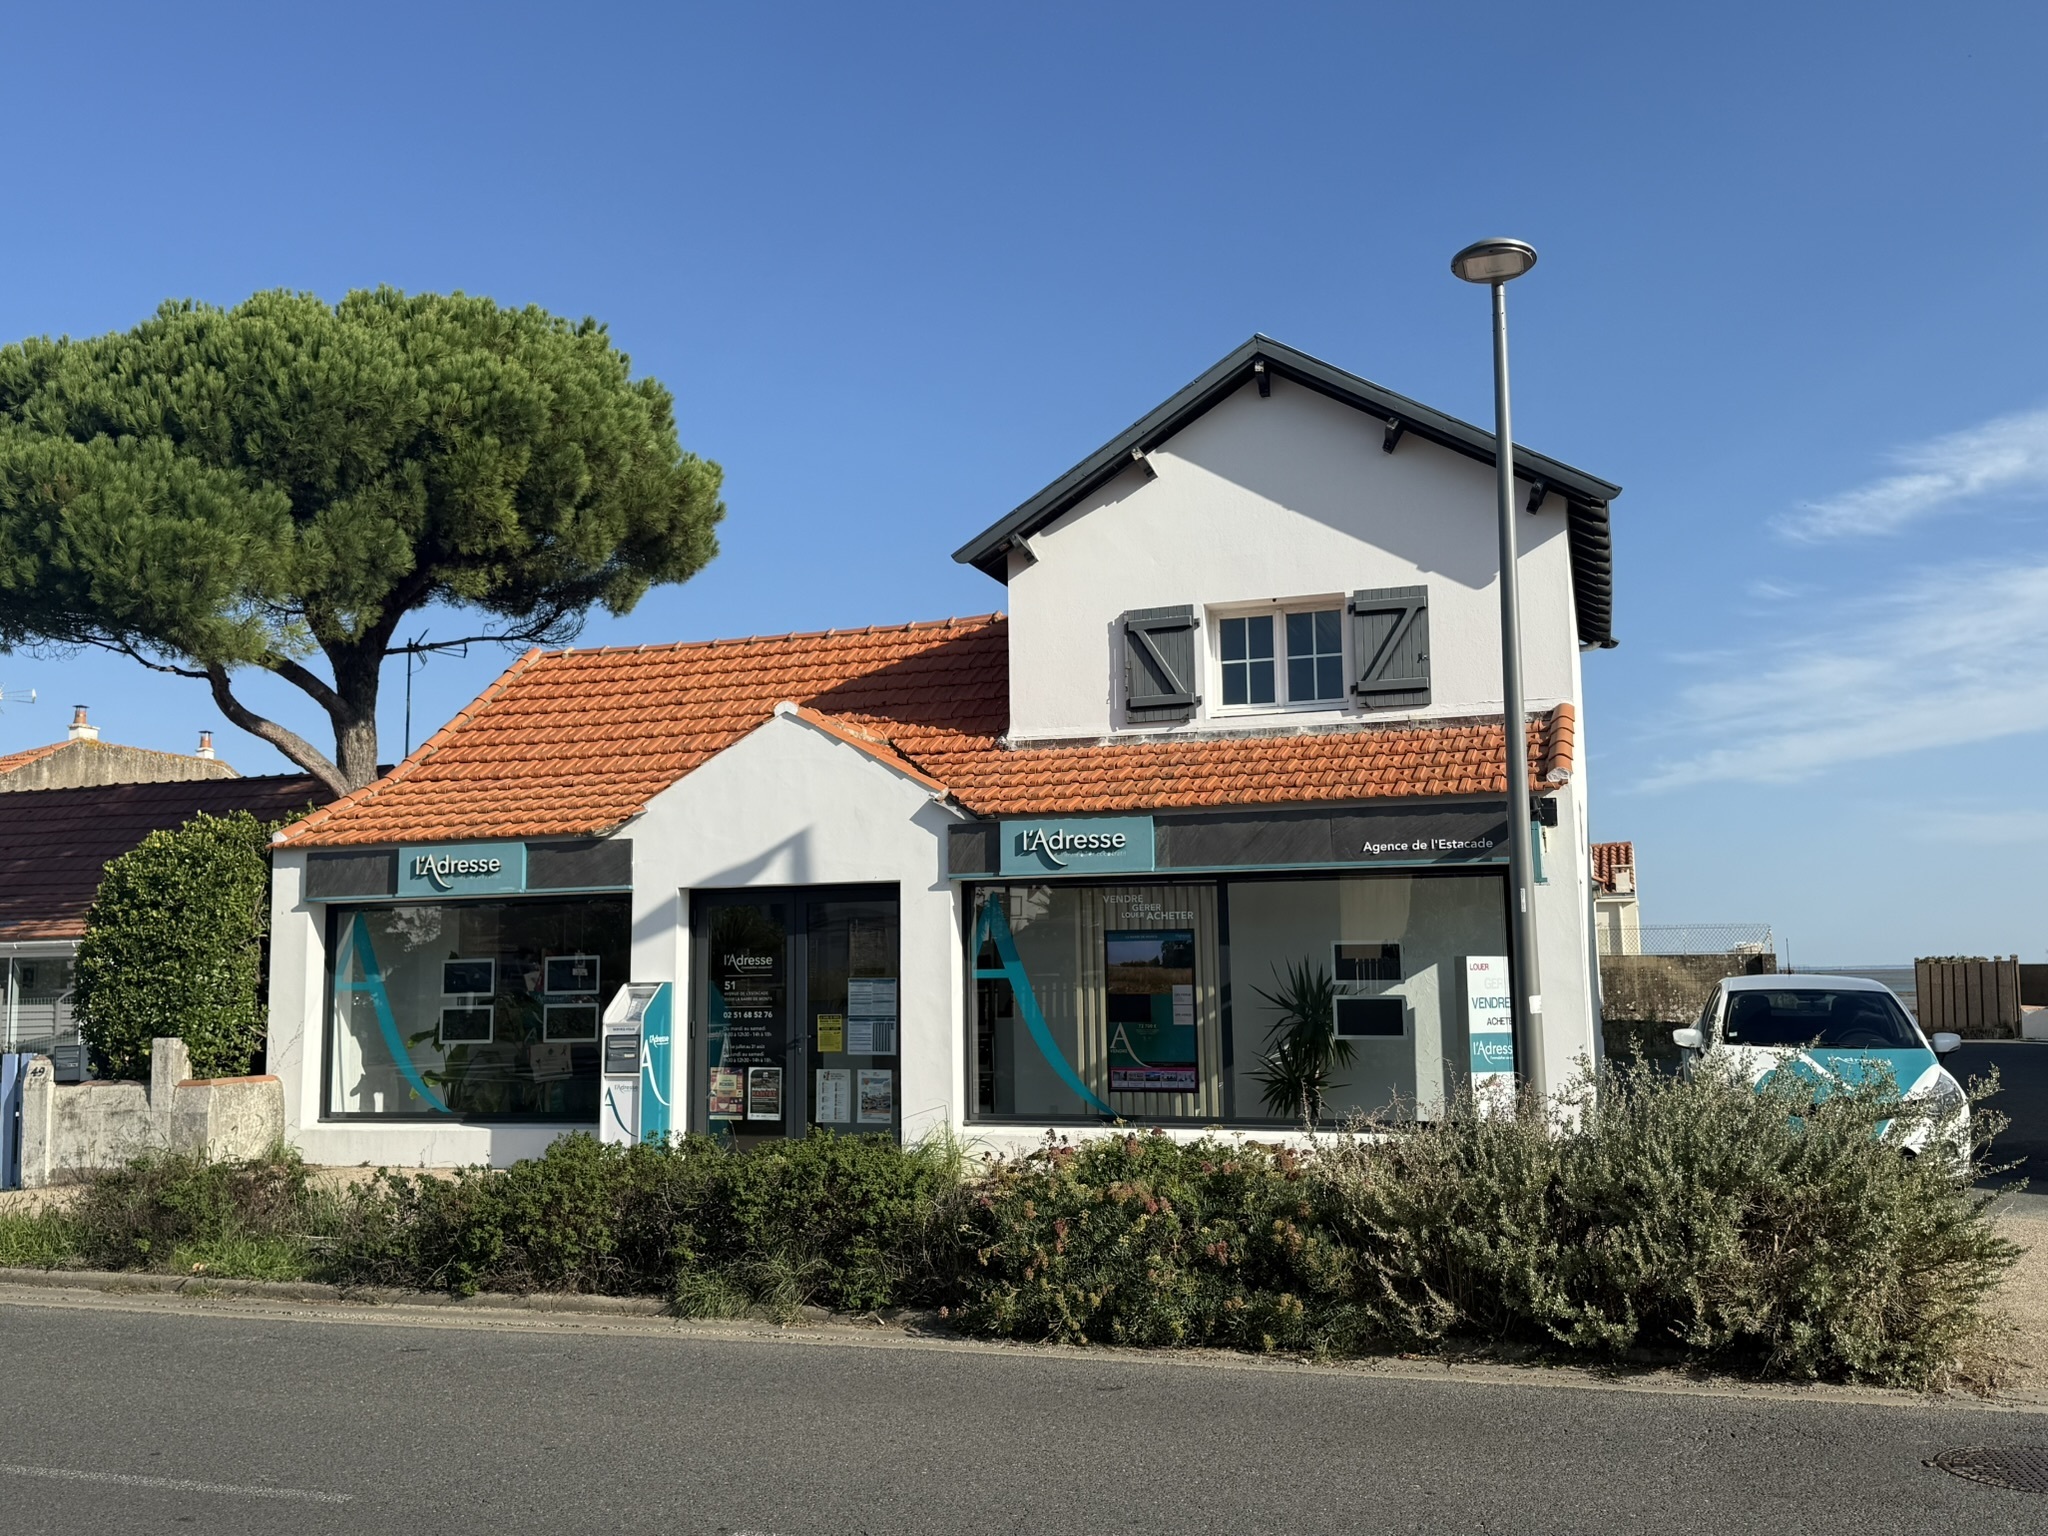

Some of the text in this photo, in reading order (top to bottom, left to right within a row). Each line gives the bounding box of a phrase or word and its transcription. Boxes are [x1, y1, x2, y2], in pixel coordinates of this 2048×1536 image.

[1023, 828, 1127, 866] l'Adresse
[1362, 837, 1494, 855] Agence de l'Estacade
[416, 853, 501, 889] l'Adresse
[1103, 894, 1144, 904] VENDRE
[1121, 910, 1194, 920] LOUER ACHETER
[724, 954, 773, 973] l'Adresse
[1469, 963, 1489, 971] LOUER
[724, 980, 736, 991] 51
[1471, 997, 1511, 1009] VENDRE
[723, 1011, 732, 1019] 02
[733, 1011, 742, 1019] 51
[753, 1011, 763, 1019] 52
[763, 1011, 773, 1019] 76
[31, 1066, 46, 1077] 49
